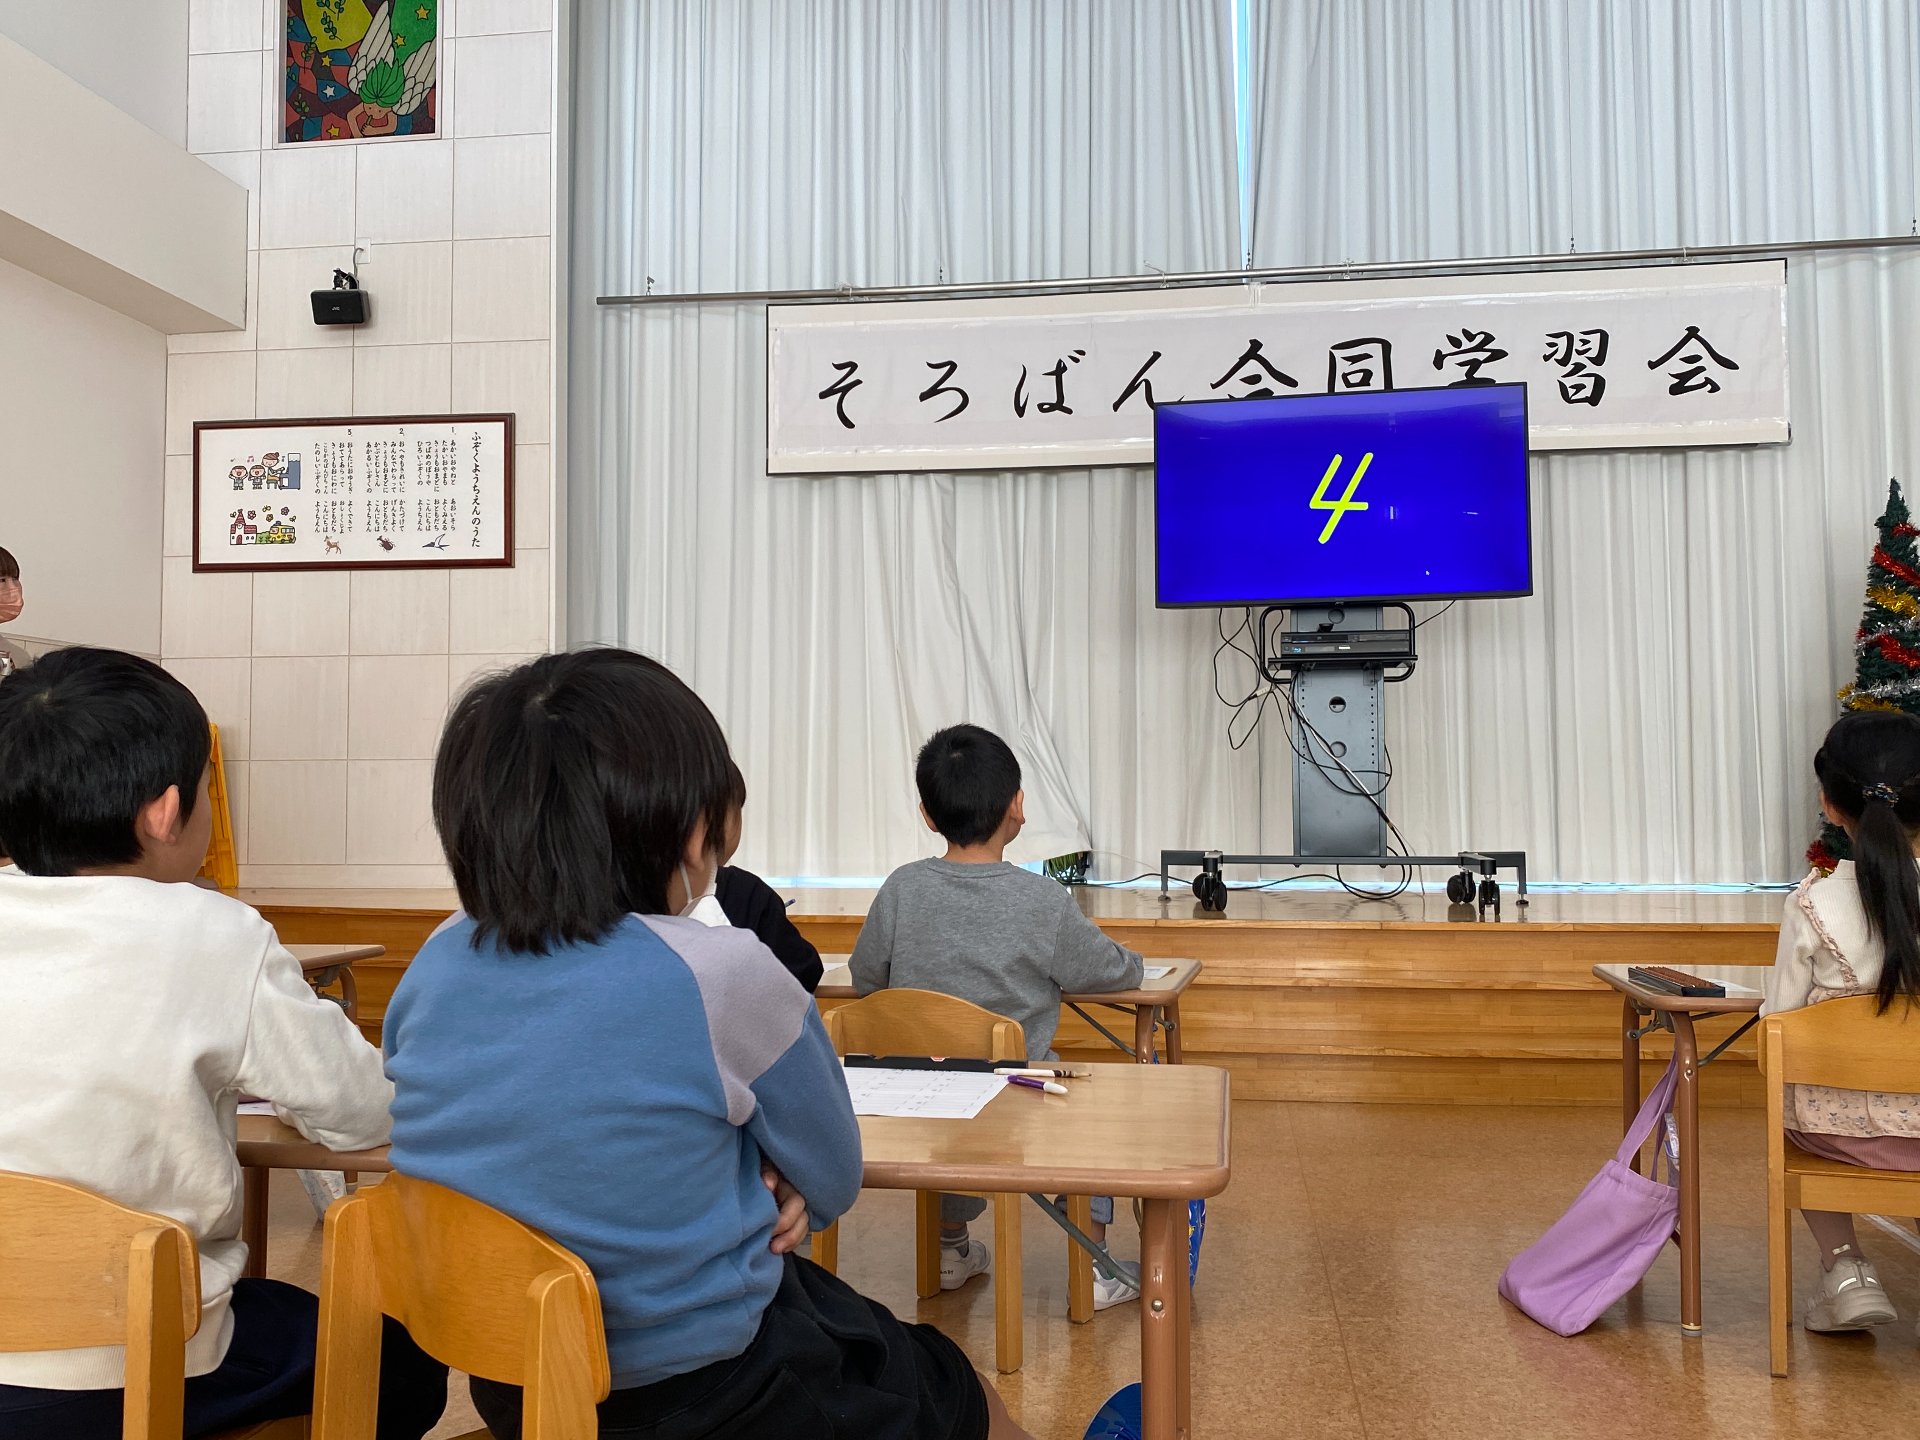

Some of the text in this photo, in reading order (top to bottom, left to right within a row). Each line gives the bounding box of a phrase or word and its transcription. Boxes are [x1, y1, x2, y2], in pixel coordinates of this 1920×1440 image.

[471, 431, 481, 548] ふぞくようちえんのうた
[1308, 452, 1373, 544] 4
